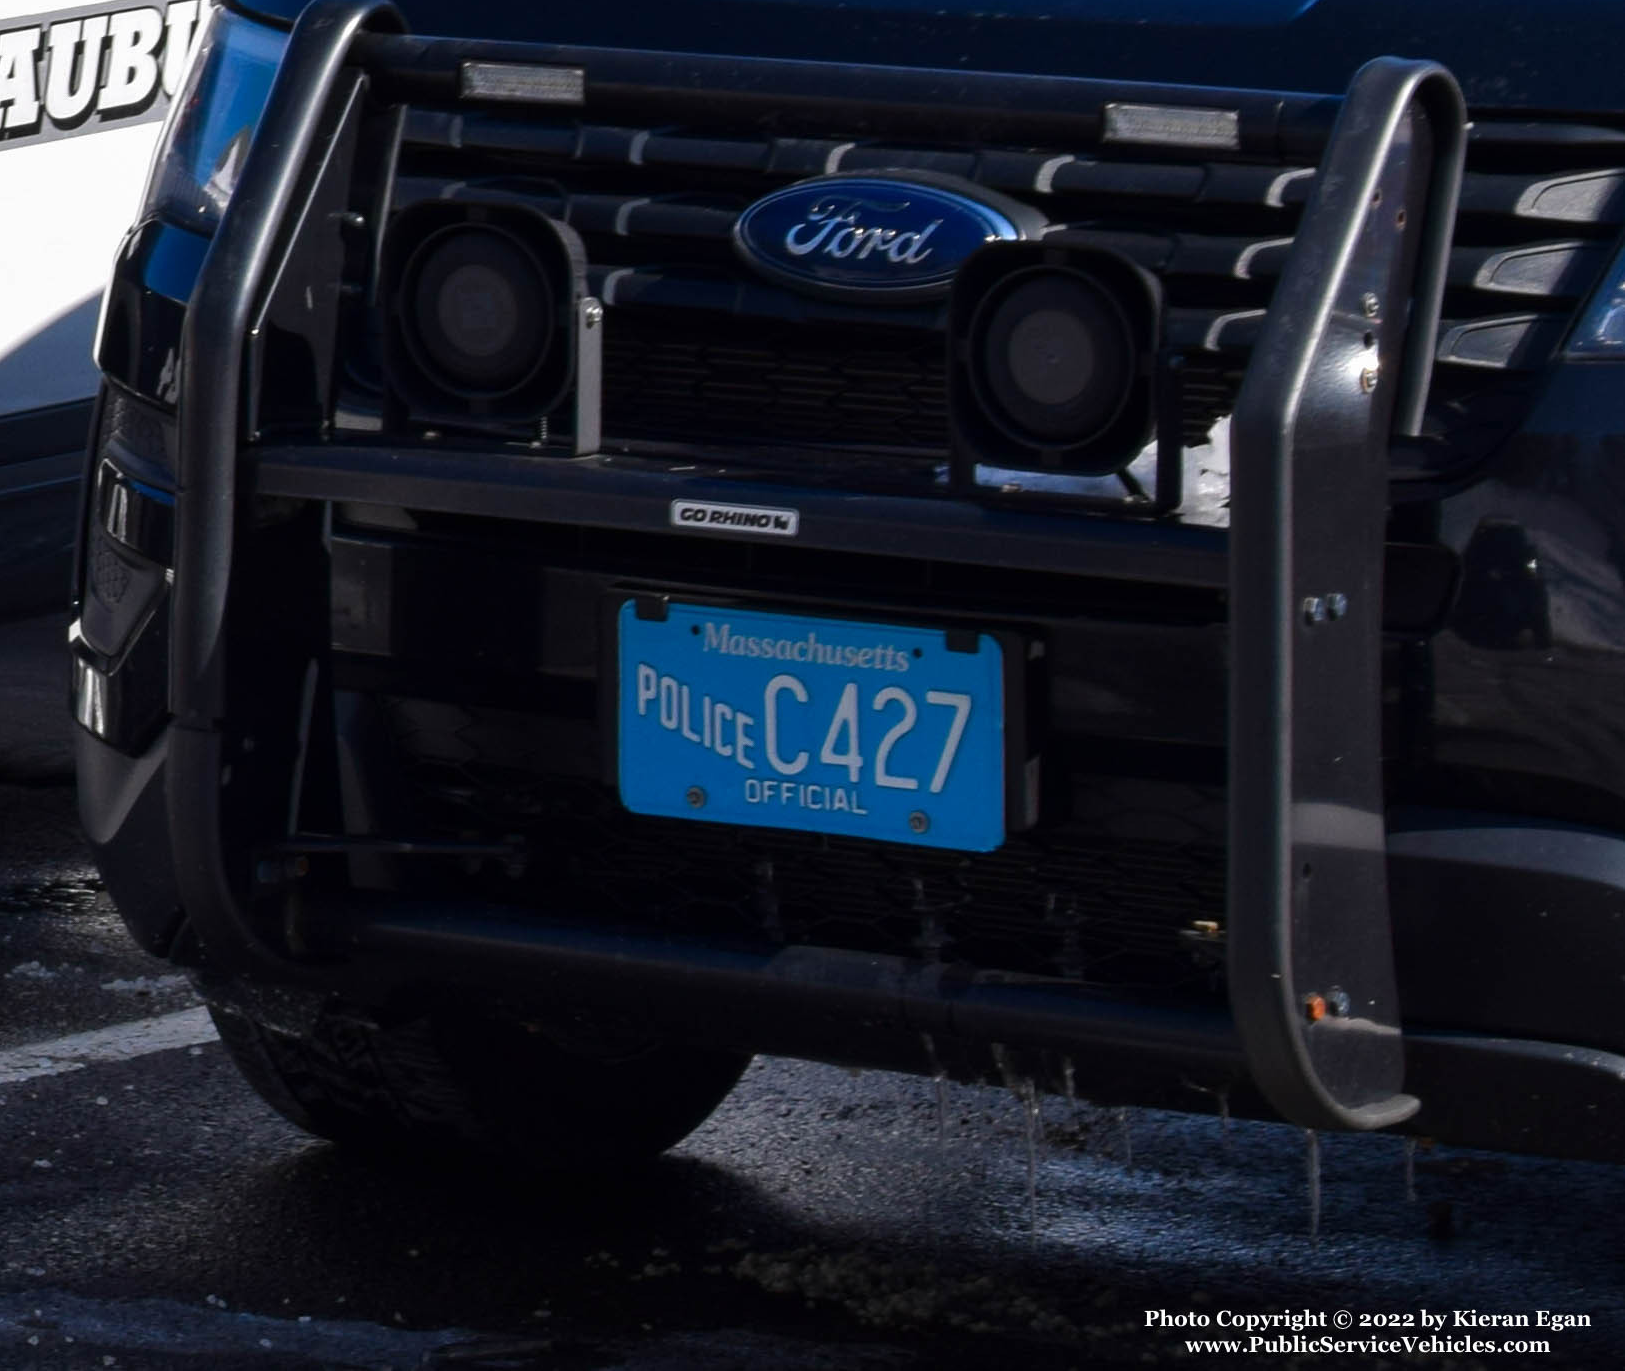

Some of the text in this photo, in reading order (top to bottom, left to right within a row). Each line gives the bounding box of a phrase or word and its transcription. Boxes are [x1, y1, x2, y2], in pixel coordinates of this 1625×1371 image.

[784, 194, 943, 266] Ford
[680, 507, 771, 528] GO RHINO
[702, 622, 911, 673] Massachusetts
[637, 663, 973, 794] POLICE C427
[745, 778, 869, 817] OFFICIAL
